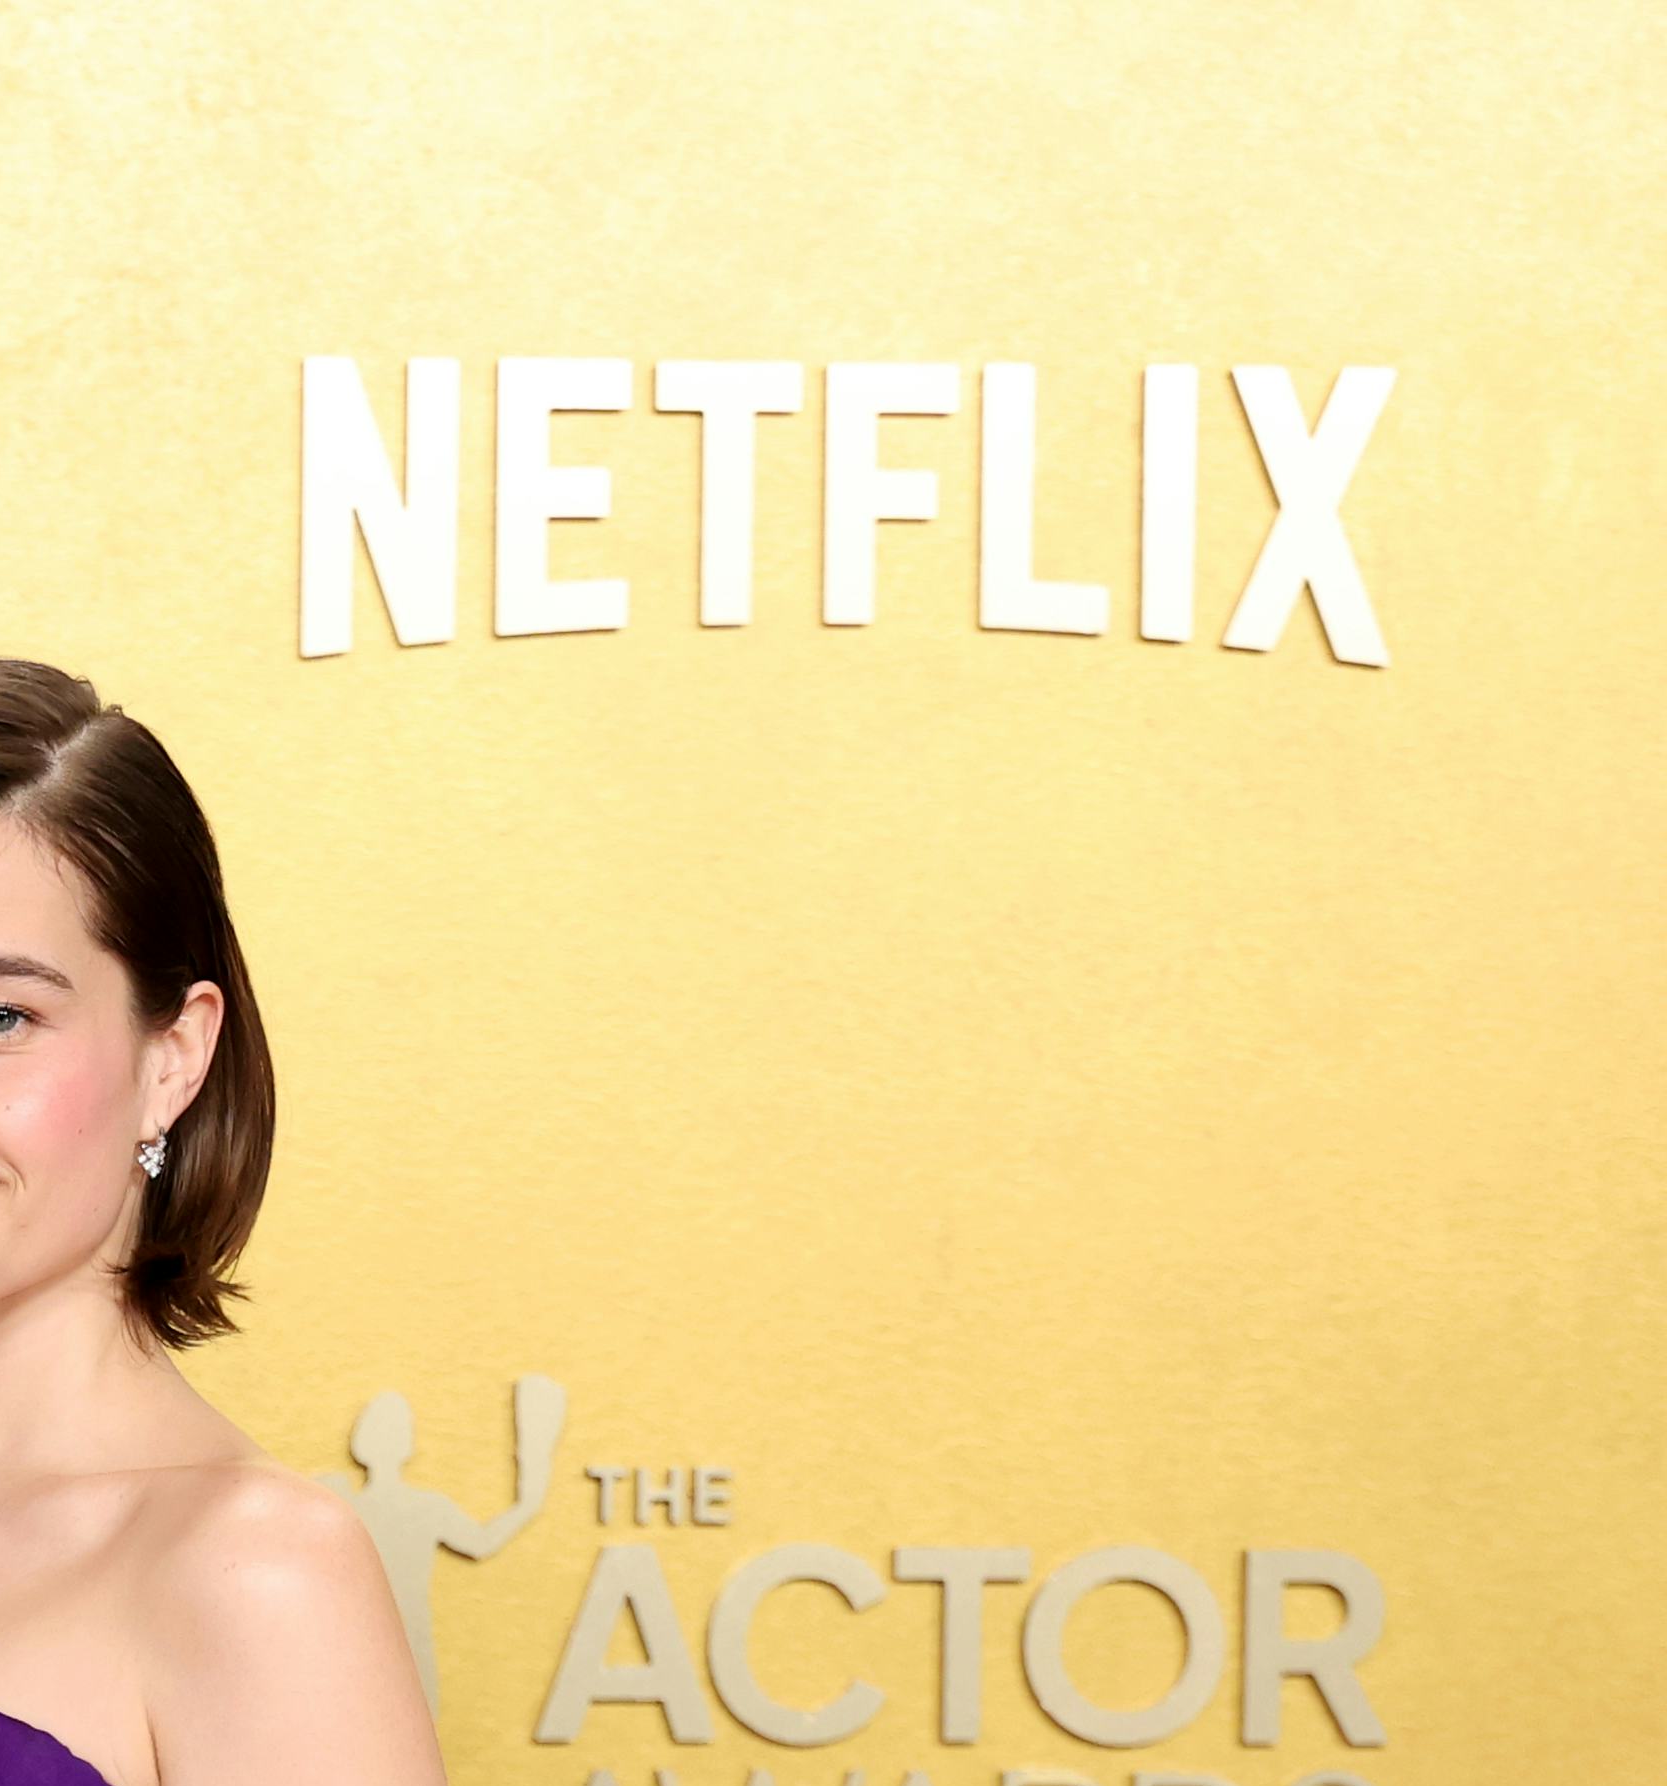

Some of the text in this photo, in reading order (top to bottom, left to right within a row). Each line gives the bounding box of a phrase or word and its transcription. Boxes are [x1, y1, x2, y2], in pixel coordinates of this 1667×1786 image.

[298, 355, 1399, 669] NETFLIX
[585, 1466, 734, 1526] THE
[531, 1542, 1387, 1748] ACTOR
